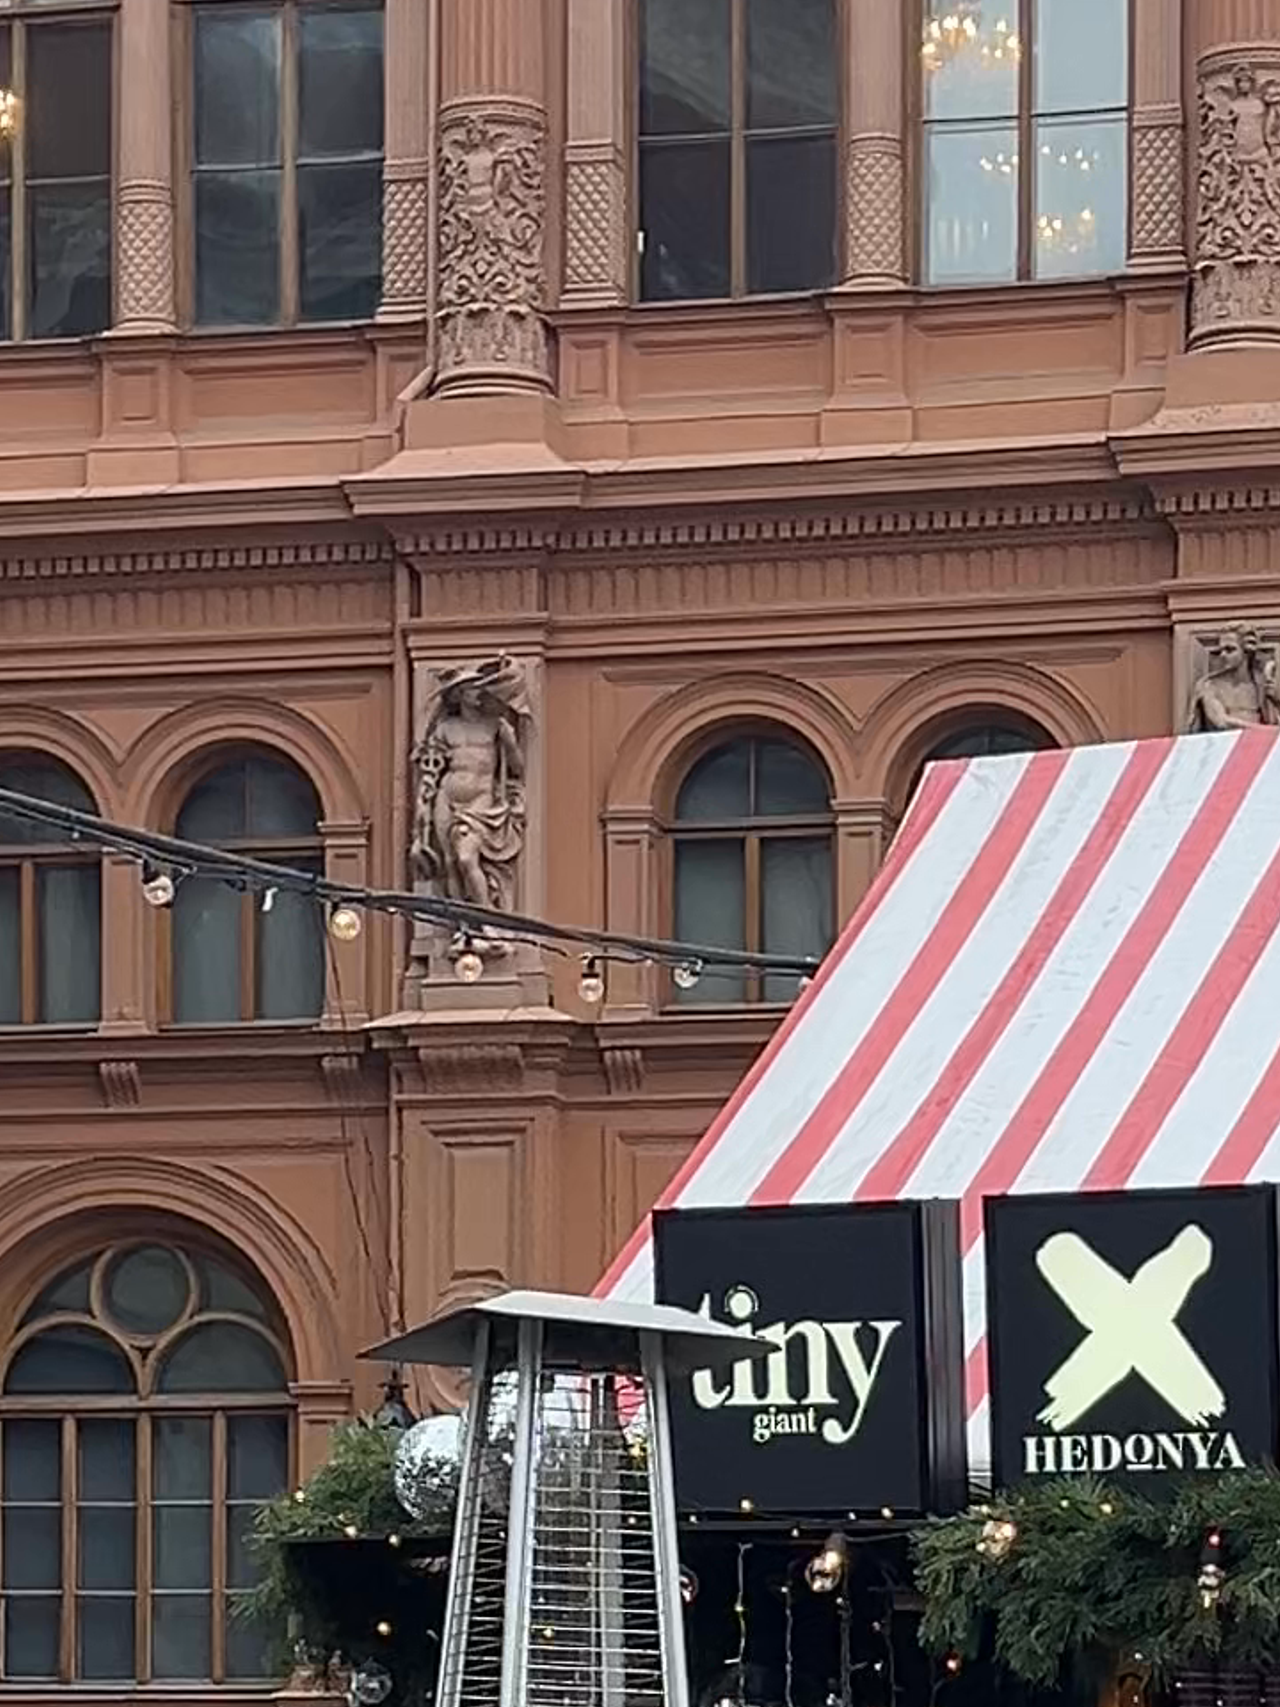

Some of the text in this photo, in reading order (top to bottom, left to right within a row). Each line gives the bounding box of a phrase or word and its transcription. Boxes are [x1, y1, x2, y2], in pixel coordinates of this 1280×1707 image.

[692, 1284, 903, 1444] tiny
[752, 1406, 817, 1442] giant
[1022, 1431, 1247, 1474] HEDONYA
